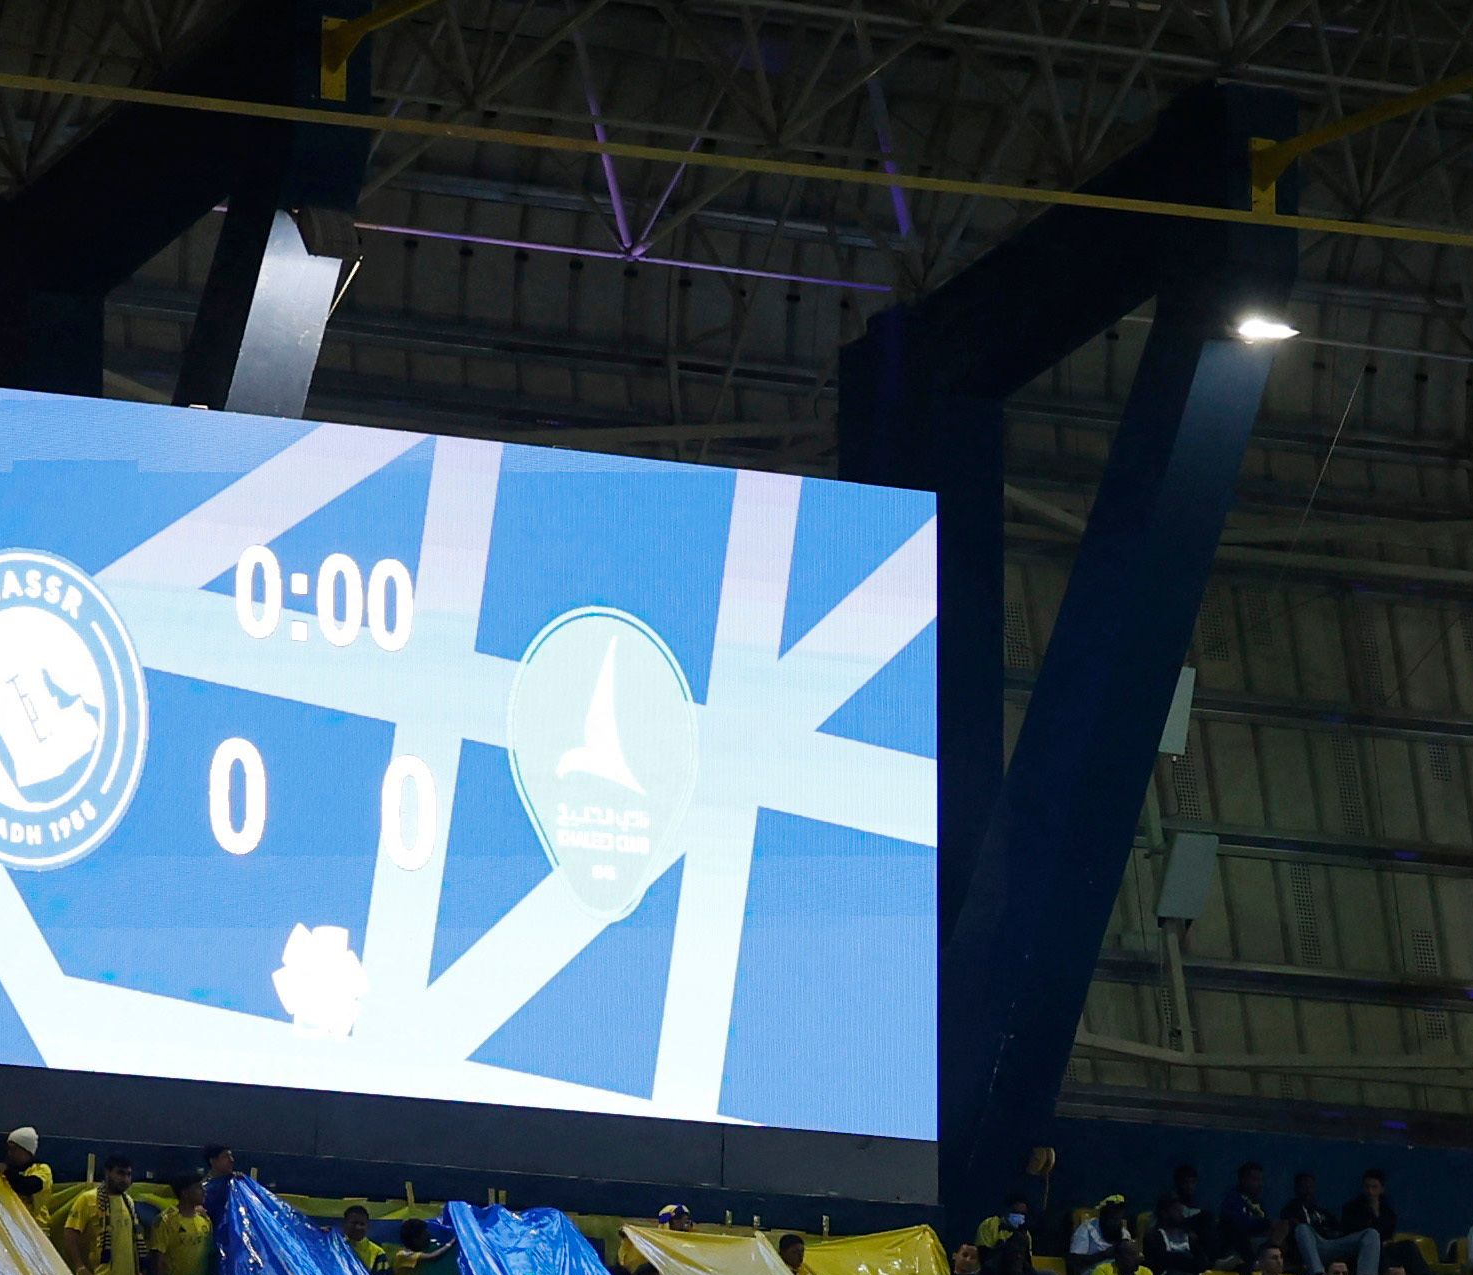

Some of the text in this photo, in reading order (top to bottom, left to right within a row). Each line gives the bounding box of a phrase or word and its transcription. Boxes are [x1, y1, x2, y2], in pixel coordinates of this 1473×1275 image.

[235, 544, 415, 652] 0:00
[209, 737, 268, 856] 0
[381, 754, 438, 872] 0
